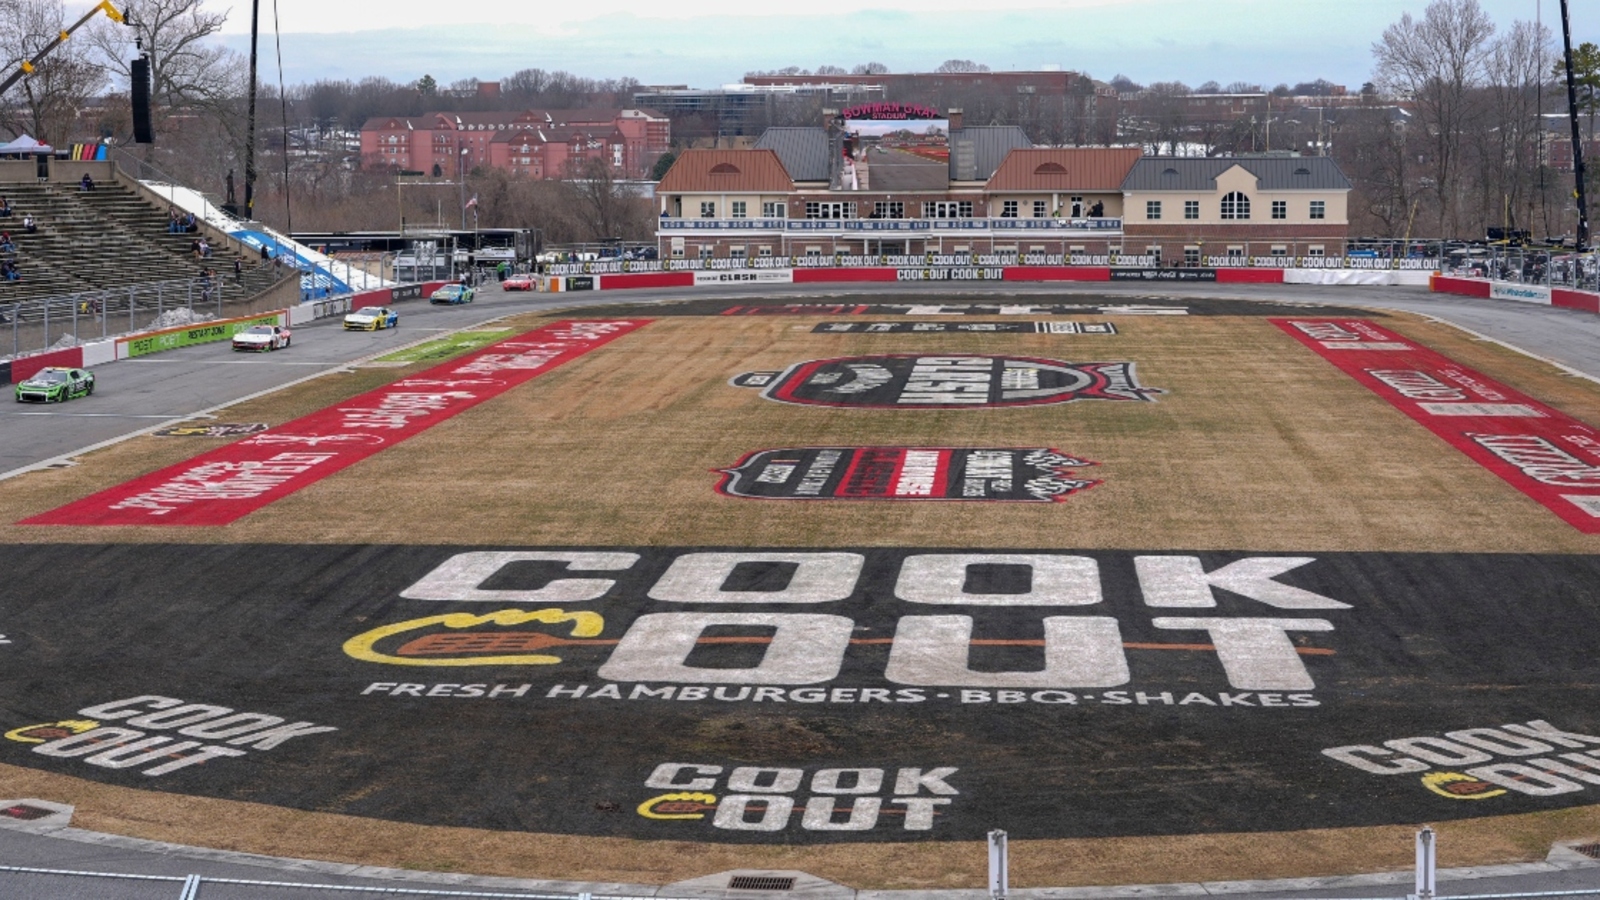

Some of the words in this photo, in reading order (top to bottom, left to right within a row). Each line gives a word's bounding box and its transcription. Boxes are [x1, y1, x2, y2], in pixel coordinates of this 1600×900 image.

[842, 101, 900, 119] BOWMAN
[904, 102, 938, 119] GRAY
[670, 260, 689, 270] COOK
[690, 260, 703, 270] OUT
[711, 259, 731, 269] COOK
[732, 259, 746, 269] OUT
[754, 257, 774, 268] COOK
[775, 257, 789, 268] OUT
[797, 256, 819, 266] COOK
[820, 256, 833, 266] OUT
[841, 255, 864, 266] COOK
[865, 255, 879, 266] OUT
[887, 255, 909, 265] COOK
[910, 255, 924, 265] OUT
[933, 255, 955, 265] COOK
[955, 255, 970, 265] OUT
[979, 255, 1000, 265] COOK
[1000, 255, 1016, 265] OUT
[1024, 255, 1046, 265] COOK
[1047, 255, 1062, 265] OUT
[1071, 255, 1091, 265] COOK
[1093, 255, 1109, 265] OUT
[1116, 255, 1138, 266] COOK
[1139, 255, 1154, 266] OUT
[1208, 256, 1230, 266] COOK
[1231, 256, 1246, 266] OUT
[1254, 256, 1276, 267] COOK
[1277, 256, 1294, 267] OUT
[1302, 257, 1325, 268] COOK
[1326, 257, 1342, 268] OUT
[1350, 258, 1373, 269] COOK
[1374, 258, 1390, 269] OUT
[1400, 259, 1422, 270] COOK
[1424, 259, 1440, 270] OUT
[550, 262, 569, 274] COOK
[570, 262, 583, 274] OUT
[590, 262, 609, 273] COOK
[610, 262, 622, 273] OUT
[630, 261, 648, 272] COOK
[649, 261, 662, 272] OUT
[897, 269, 924, 280] COOK
[930, 269, 948, 279] OUT
[951, 269, 978, 279] COOK
[984, 268, 1003, 279] OUT
[188, 328, 211, 339] RESTART
[212, 326, 225, 336] ZONE
[160, 333, 180, 346] POET
[898, 356, 993, 404] CLASH
[1464, 432, 1600, 488] GRIZZLY
[844, 448, 900, 496] CLASSIC
[896, 450, 940, 496] MADHOUSE
[399, 550, 1354, 610] COOK
[598, 612, 1335, 690] OUT
[360, 682, 532, 698] FRESH
[546, 682, 926, 703] HAMBURGERS
[960, 689, 1080, 704] BBQ
[1100, 690, 1321, 707] SHAKES
[77, 695, 339, 750] COOK
[31, 727, 247, 776] OUT
[1321, 719, 1600, 775] COOK
[644, 762, 960, 795] COOK
[712, 794, 952, 831] OUT
